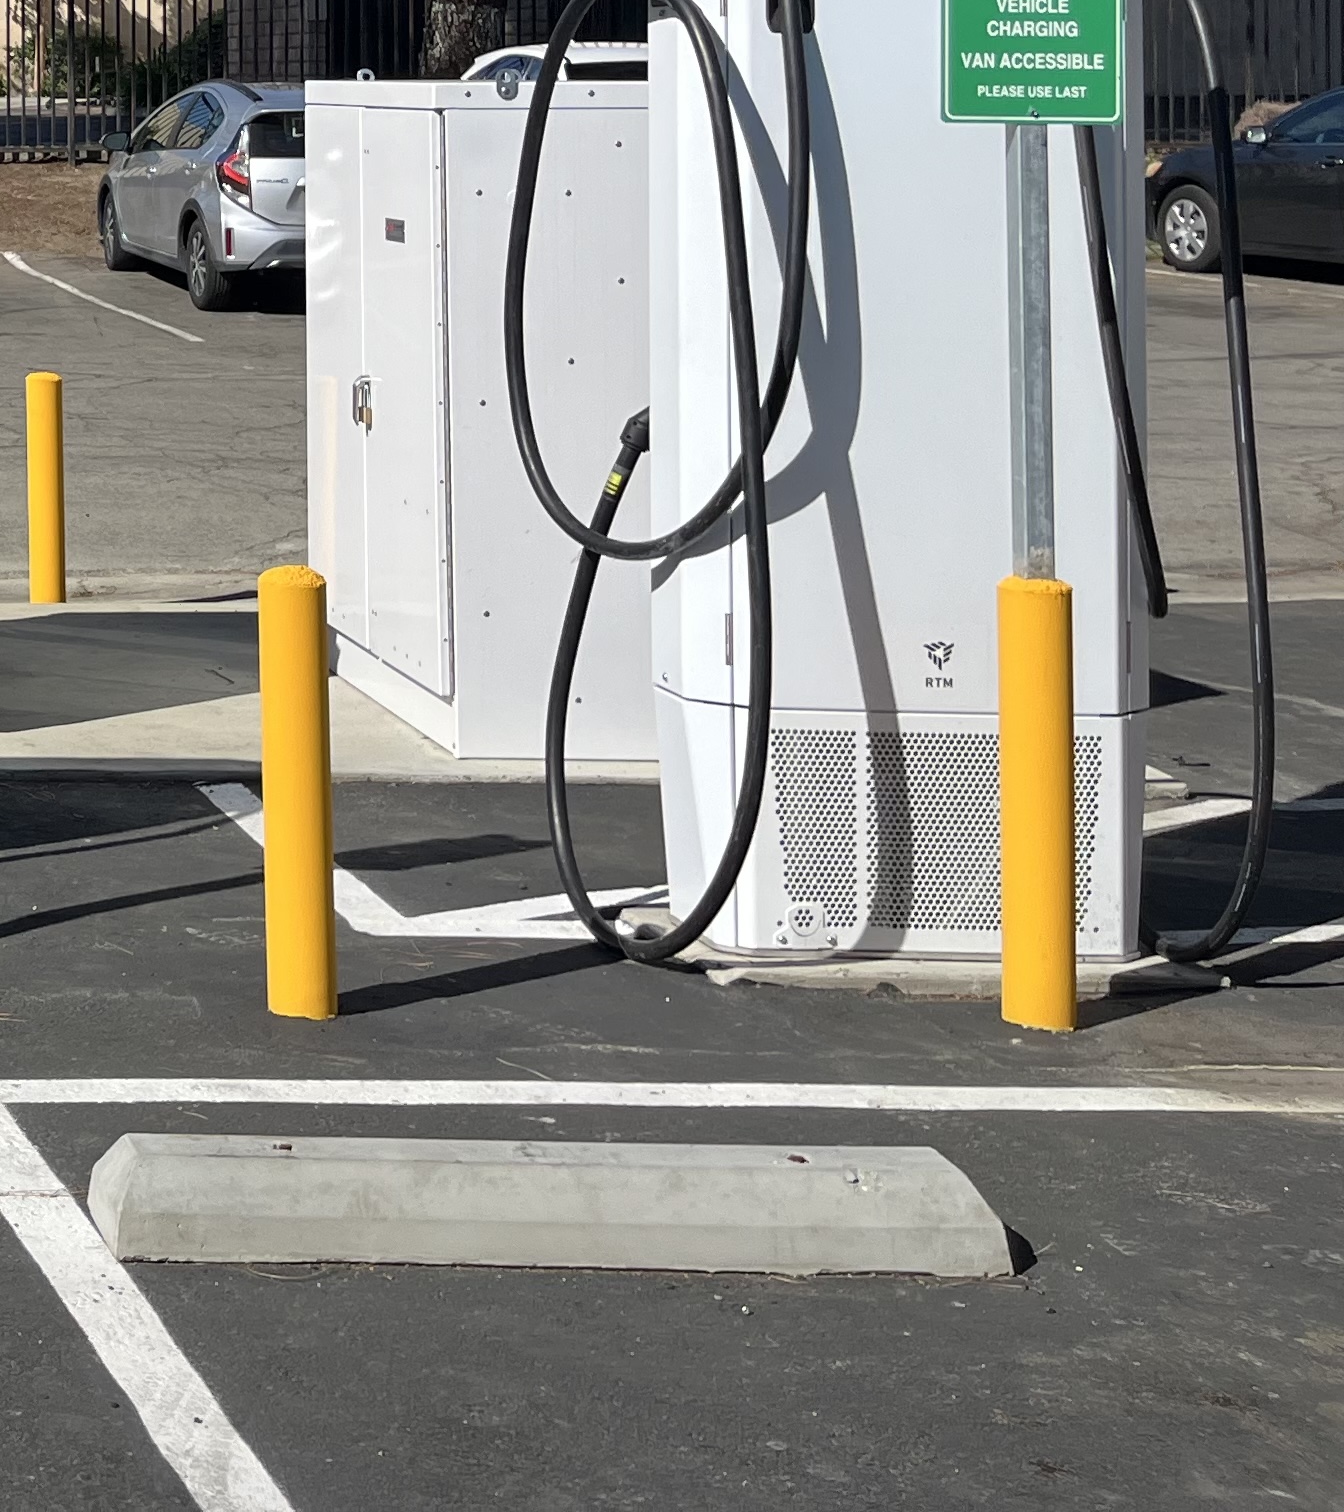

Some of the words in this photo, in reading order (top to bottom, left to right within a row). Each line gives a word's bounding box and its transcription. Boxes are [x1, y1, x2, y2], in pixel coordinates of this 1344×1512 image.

[986, 20, 1079, 38] CHARGING
[960, 52, 996, 69] VAN
[999, 53, 1105, 70] ACCESSIBLE
[977, 85, 1025, 98] PLEASE
[1027, 86, 1053, 99] USE
[1055, 86, 1087, 99] LAST
[925, 677, 954, 688] RTM
